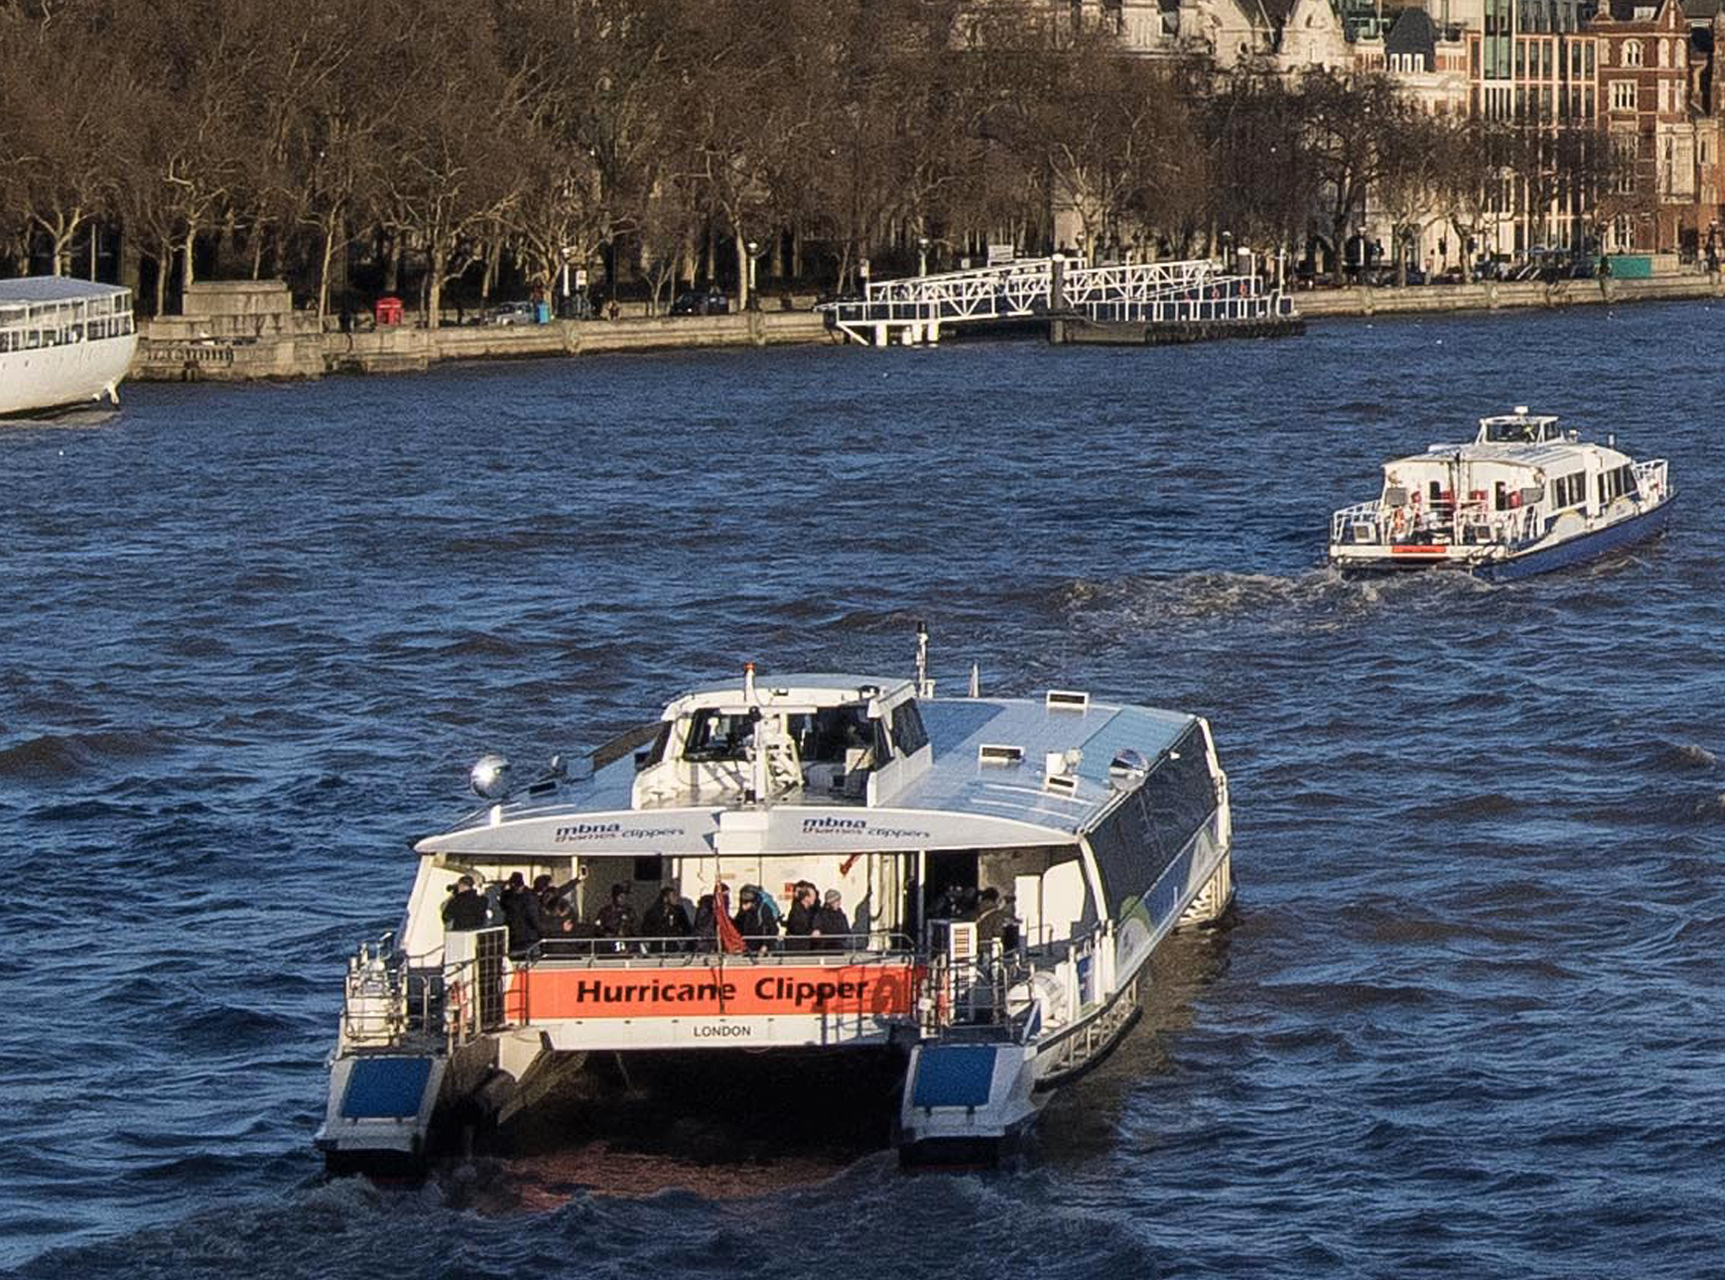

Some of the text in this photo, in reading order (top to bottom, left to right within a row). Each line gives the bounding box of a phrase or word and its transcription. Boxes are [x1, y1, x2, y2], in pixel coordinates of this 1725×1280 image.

[803, 816, 867, 829] mbna
[556, 823, 620, 836] mbna
[576, 975, 869, 1007] Hurricane Clipper
[693, 1025, 751, 1038] LONDON
